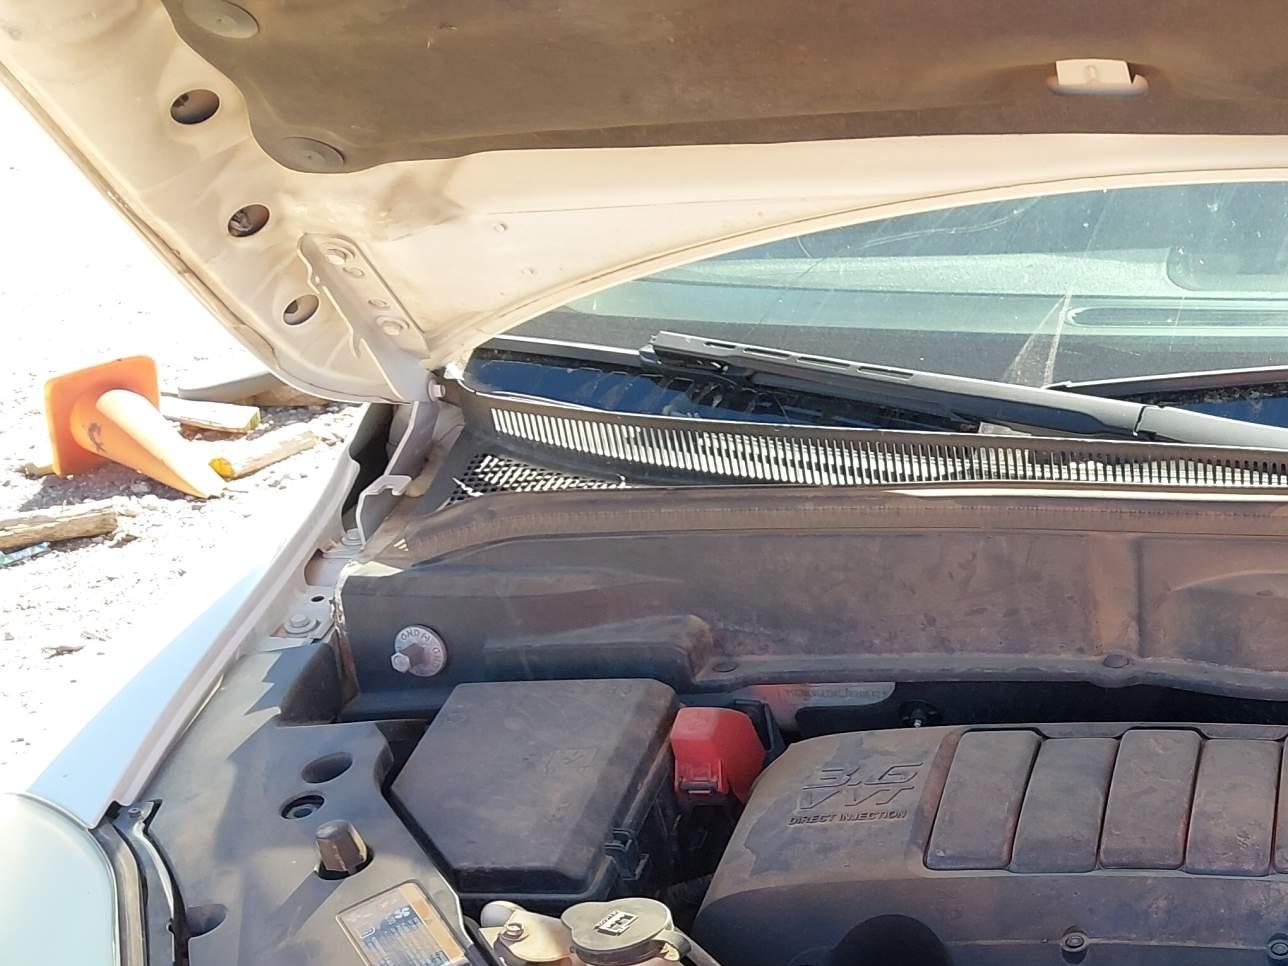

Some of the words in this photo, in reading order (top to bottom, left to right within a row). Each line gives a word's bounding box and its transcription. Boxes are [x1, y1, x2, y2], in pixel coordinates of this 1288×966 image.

[801, 762, 924, 789] 3.6
[788, 813, 837, 826] DIRECT
[838, 809, 908, 823] INJECTION
